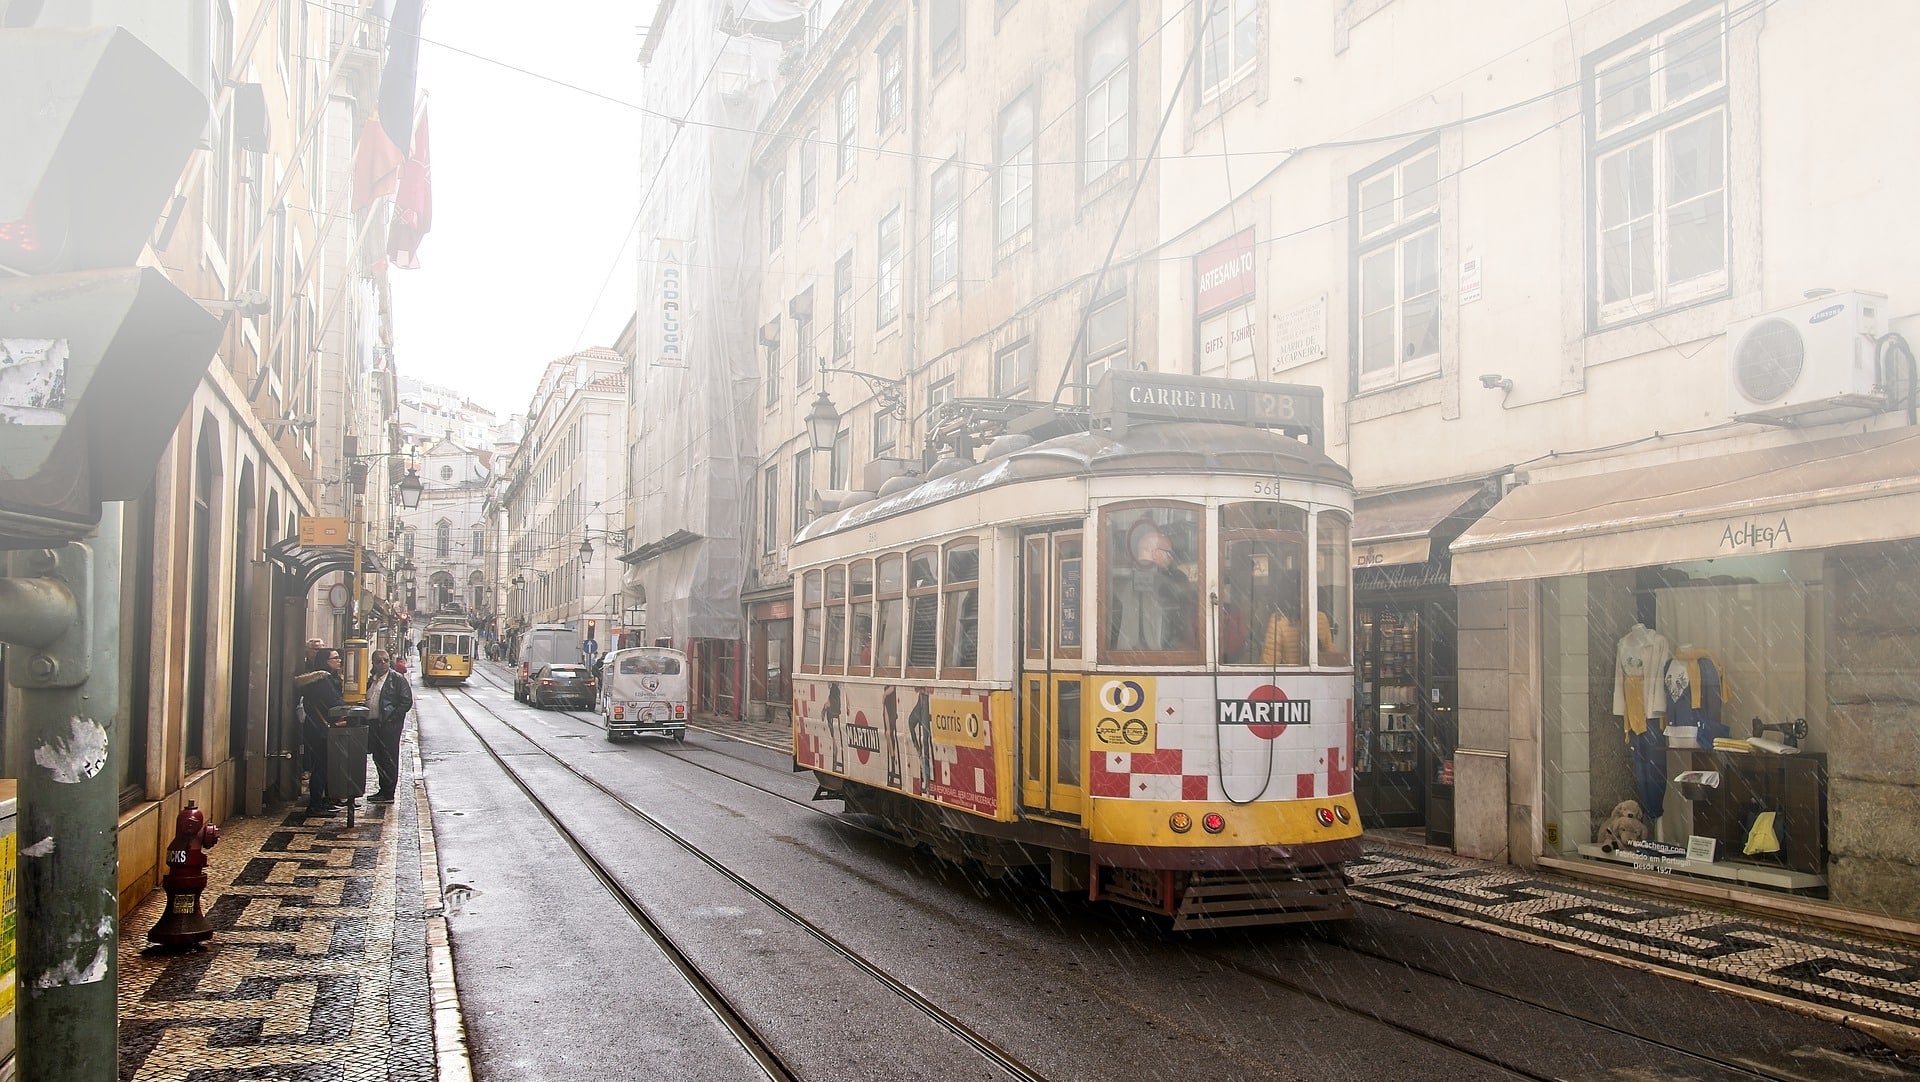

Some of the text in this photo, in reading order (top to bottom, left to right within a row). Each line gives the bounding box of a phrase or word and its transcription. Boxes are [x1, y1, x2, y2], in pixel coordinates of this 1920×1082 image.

[663, 268, 680, 354] ANDALUGA
[1205, 336, 1224, 354] GIFTS
[1129, 386, 1236, 411] CARREIRA
[1254, 481, 1280, 496] 568
[1358, 553, 1384, 566] DMC
[936, 710, 962, 733] carris
[1220, 702, 1309, 722] MARTINI
[846, 725, 879, 750] MARTINI
[1615, 849, 1648, 861] Fabricado
[1661, 856, 1691, 868] Portugal
[1633, 862, 1654, 871] Desde
